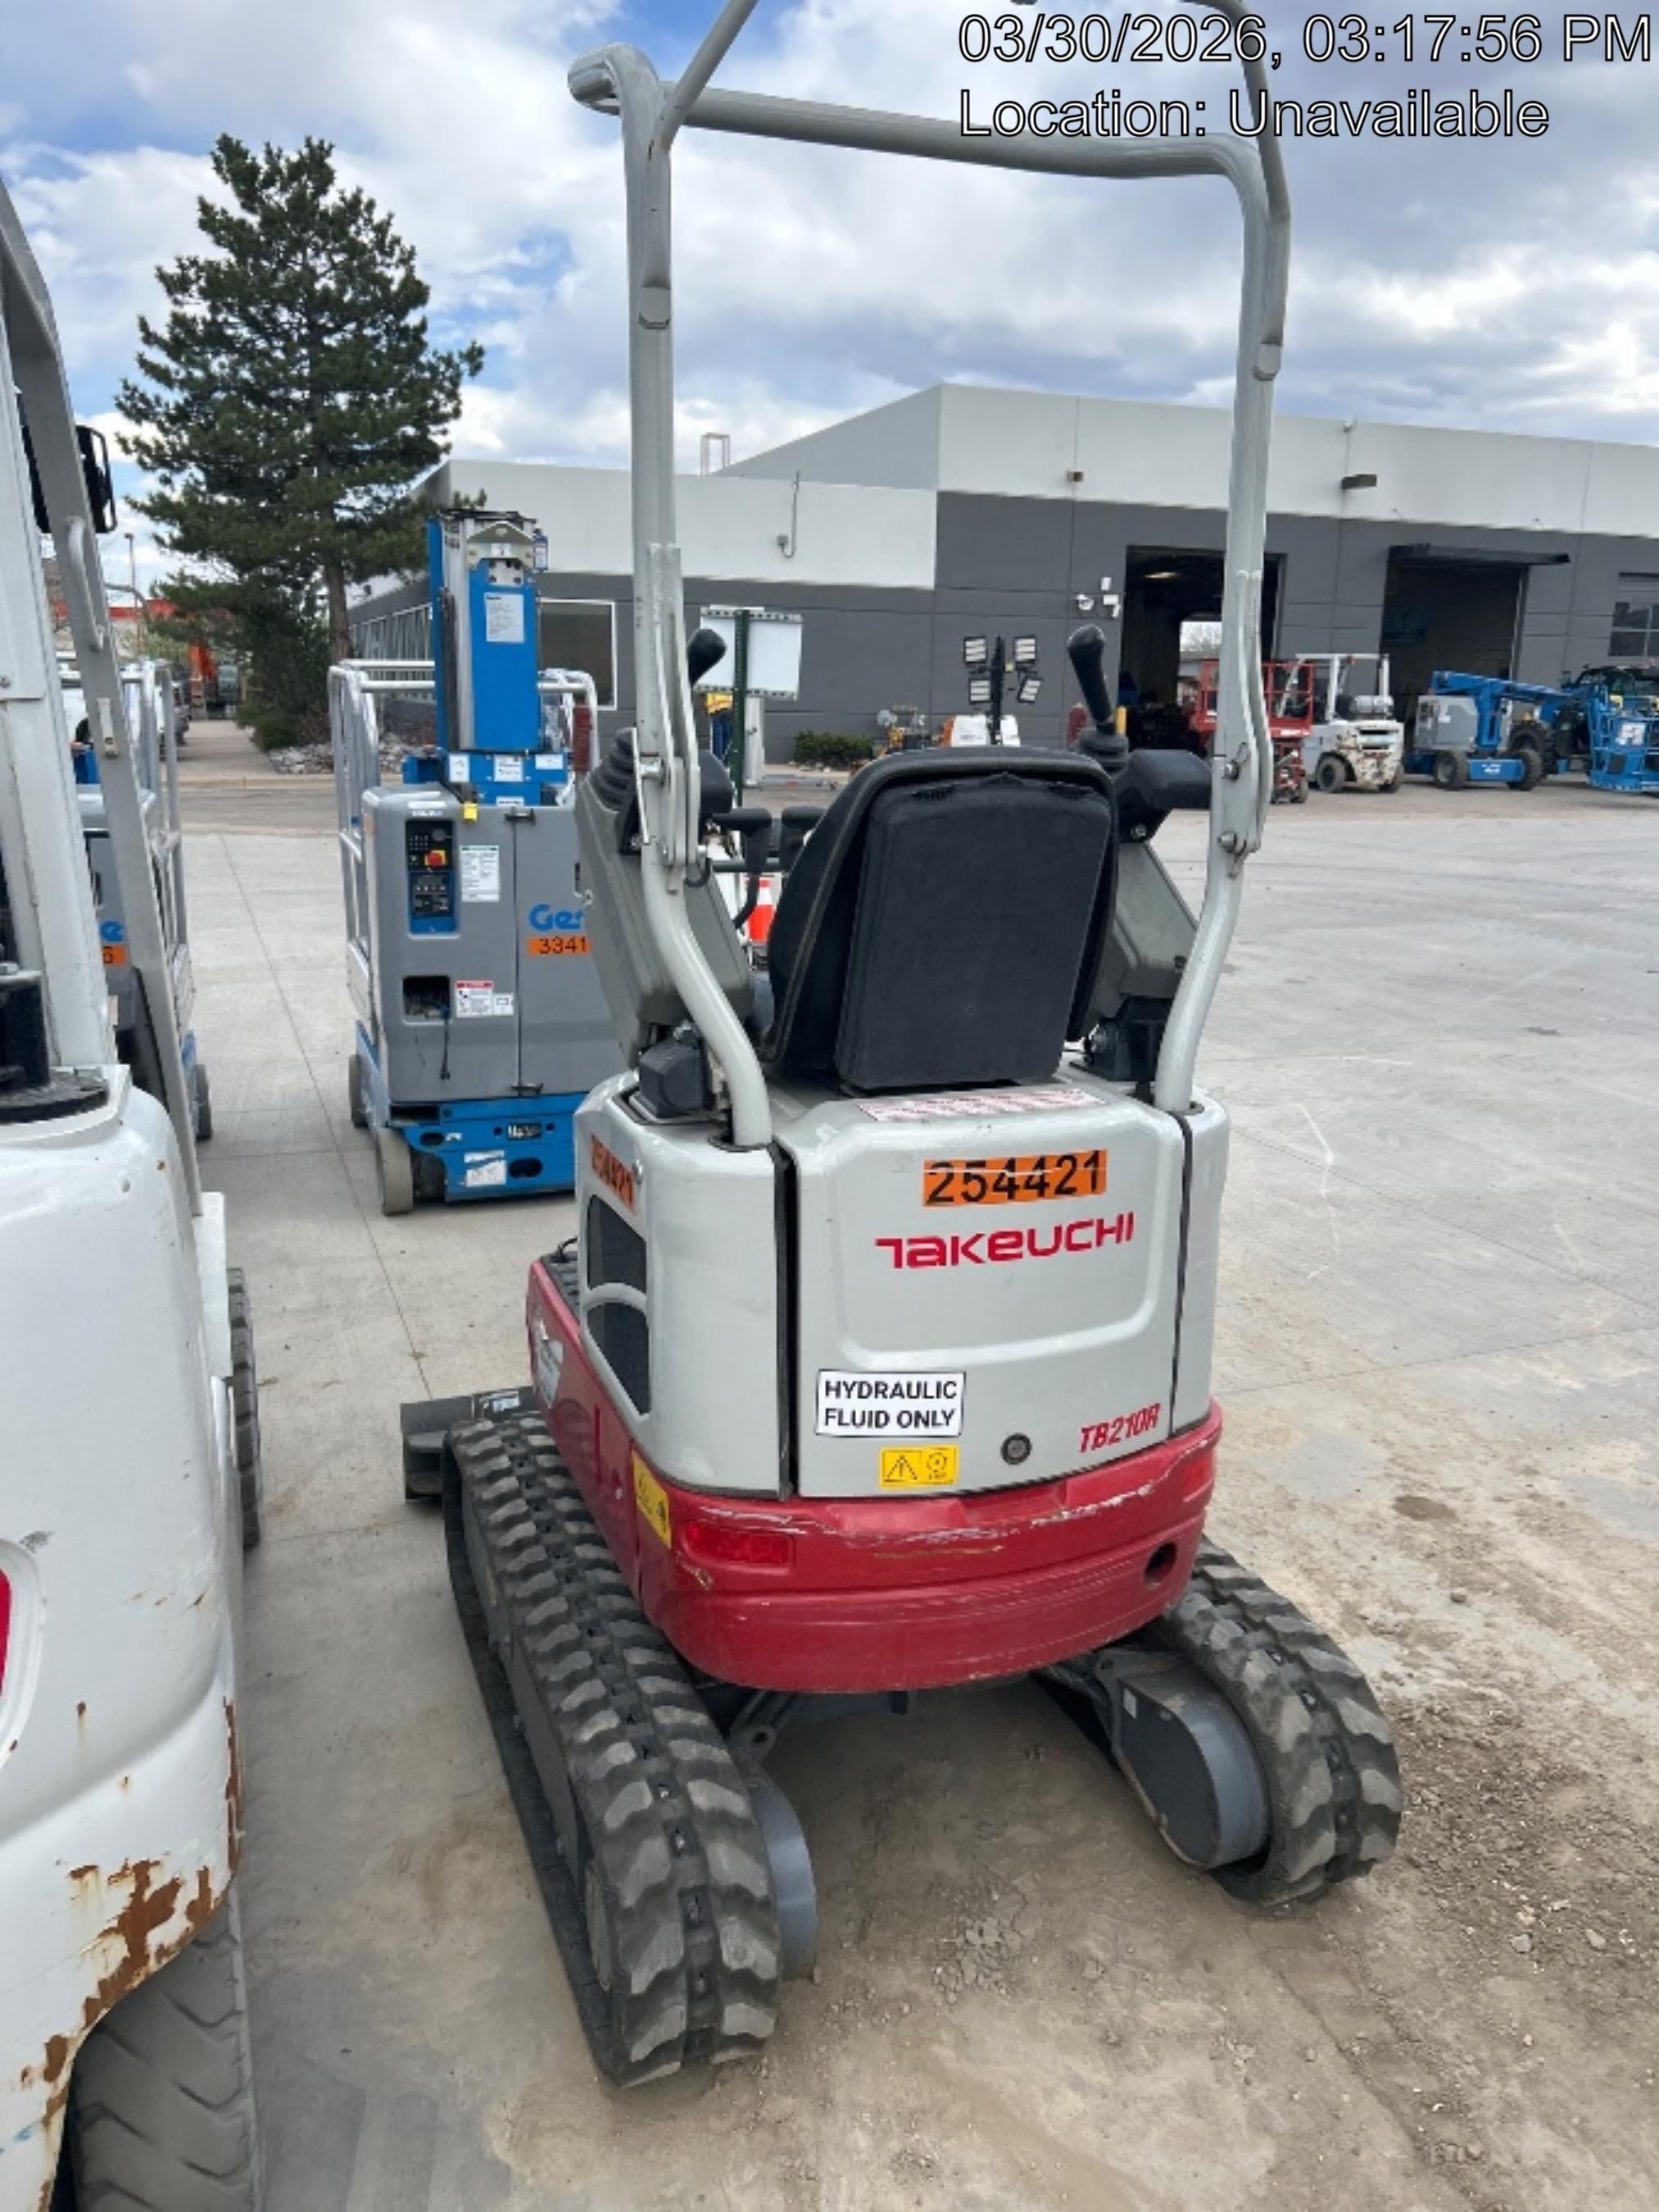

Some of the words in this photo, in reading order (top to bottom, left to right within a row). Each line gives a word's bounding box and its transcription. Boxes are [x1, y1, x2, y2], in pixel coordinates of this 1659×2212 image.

[926, 1150, 1100, 1205] 254421
[825, 1380, 957, 1399] HYDRAULIC
[824, 1407, 890, 1428] FLUID
[896, 1408, 956, 1429] ONLY
[1081, 1403, 1160, 1453] TB210R
